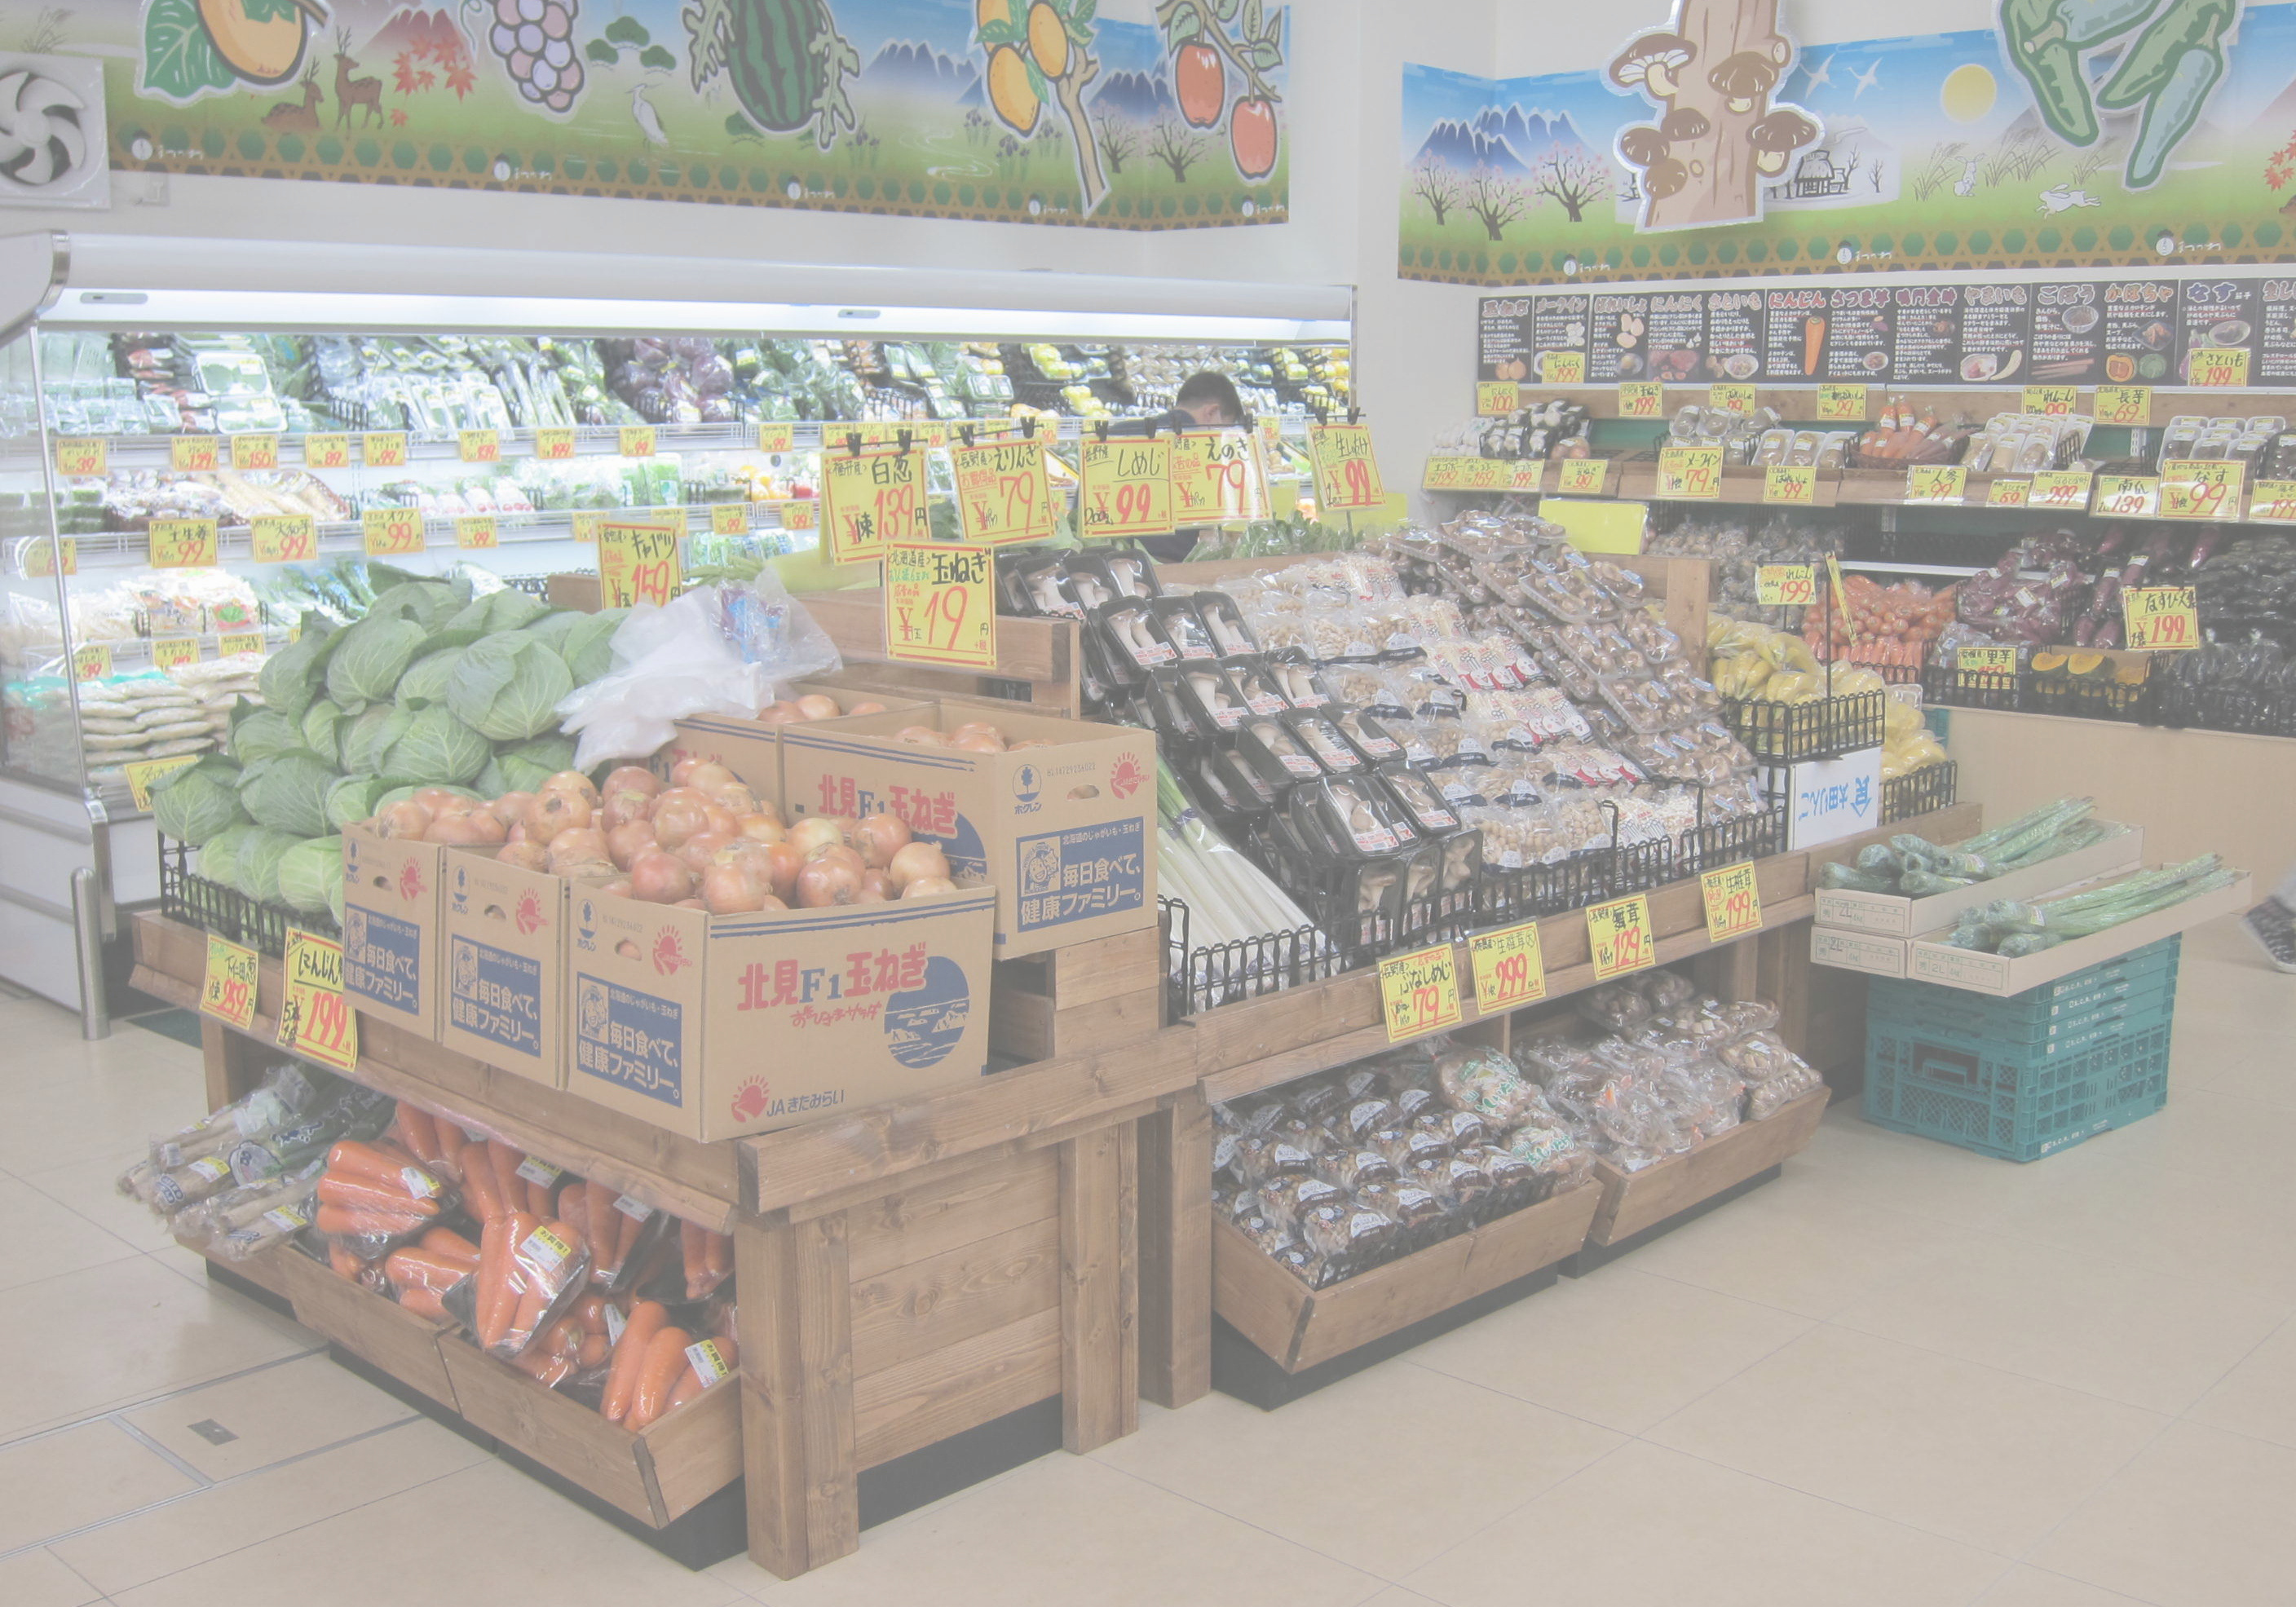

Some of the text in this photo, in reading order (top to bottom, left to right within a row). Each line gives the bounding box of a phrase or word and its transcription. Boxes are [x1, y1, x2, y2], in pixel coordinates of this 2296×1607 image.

[1650, 294, 1703, 312] にんにく
[1707, 291, 1763, 311] さといも
[1768, 290, 1826, 309] にんじん
[1830, 289, 1891, 309] さつま芋
[1895, 286, 1958, 307] 鳴門金時
[1963, 285, 2028, 306] やまいも
[2104, 282, 2175, 303] かぼちゃ
[2186, 281, 2237, 303] なす
[2205, 352, 2244, 367] さといも
[1556, 367, 1578, 382] 199
[2203, 366, 2232, 386] 199
[1633, 396, 1655, 416] 199
[1835, 400, 1855, 417] 29
[2116, 389, 2145, 404] 長芋
[2113, 403, 2140, 423] 69
[1204, 435, 1249, 461] えのき
[1117, 447, 1165, 477] しめじ
[1205, 459, 1246, 514] 79
[1344, 457, 1372, 507] 99
[1685, 467, 1711, 492] 79
[1930, 469, 1960, 484] 人参
[2194, 468, 2230, 484] なす
[998, 470, 1035, 535] 79
[1115, 483, 1152, 525] 99
[1783, 483, 1804, 499] 99
[1930, 483, 1954, 501] 99
[2110, 495, 2145, 514] 139
[2189, 482, 2228, 515] 99
[873, 483, 915, 541] 139
[914, 506, 928, 527] 円
[279, 534, 309, 561] 99
[387, 522, 413, 550] 99
[630, 528, 676, 560] キャベツ
[177, 539, 205, 565] 99
[931, 546, 992, 585] 玉ねぎ
[630, 559, 670, 608] 159
[1779, 579, 1812, 603] 199
[922, 585, 969, 651] 19
[979, 621, 990, 637] 円
[2151, 614, 2186, 643] 199
[1013, 802, 1043, 815] ホクレン
[1062, 821, 1141, 845] 北海道のじゃがいも・玉ねぎ
[1063, 852, 1141, 888] 毎日食べて、
[1020, 883, 1141, 925] 健康ファミリー。
[1725, 889, 1751, 931] 199
[366, 943, 417, 981] 毎日食べて、
[1613, 926, 1640, 971] 129
[736, 941, 927, 1012] 北見F1玉ねぎ
[1495, 952, 1528, 1000] 299
[1931, 963, 1945, 975] 2L
[344, 960, 419, 1009] 健康ファミリー。
[478, 978, 538, 1020] 毎日食べて、
[1411, 985, 1440, 1028] 79
[302, 990, 348, 1051] 199
[452, 996, 540, 1049] 健康ファミリー。
[610, 1021, 679, 1068] 毎日食べて、
[579, 1040, 681, 1099] 健康ファミリー。
